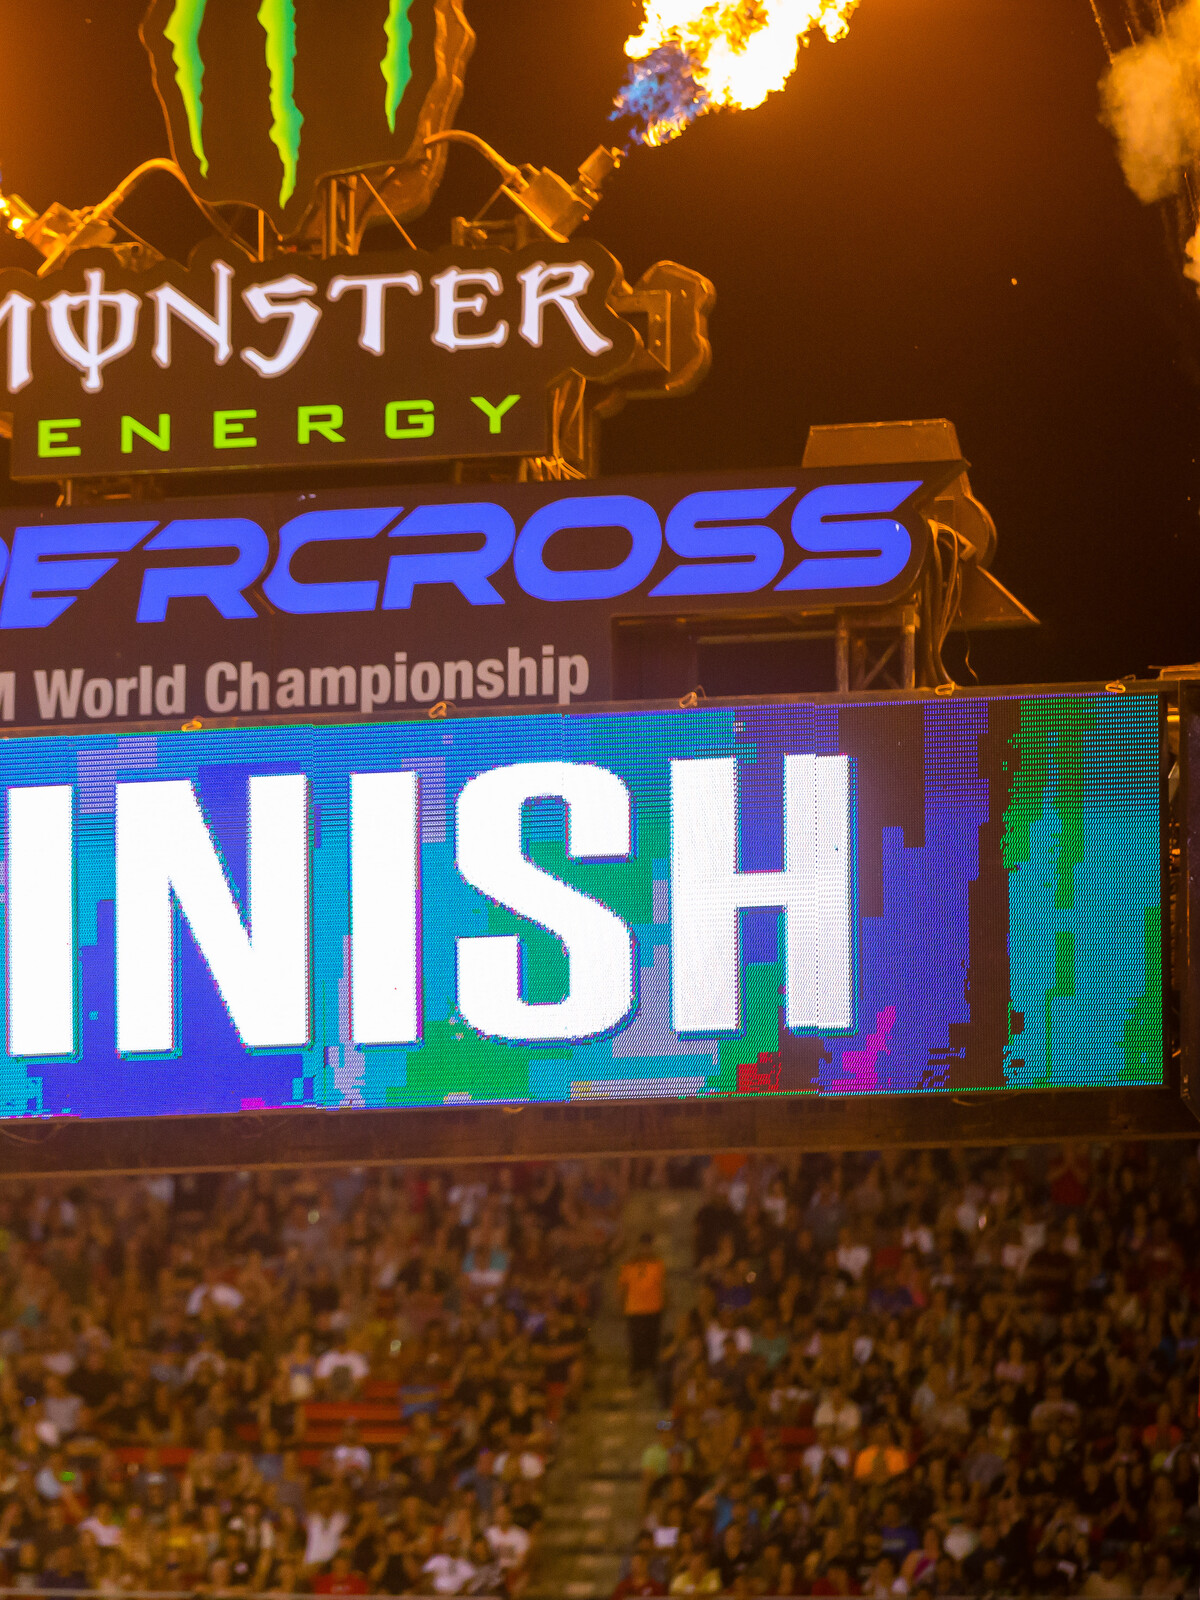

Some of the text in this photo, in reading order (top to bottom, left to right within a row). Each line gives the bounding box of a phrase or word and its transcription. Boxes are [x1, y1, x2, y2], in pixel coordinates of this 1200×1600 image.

[38, 395, 522, 459] ENERGY
[34, 664, 186, 718] World
[205, 645, 590, 713] Championship
